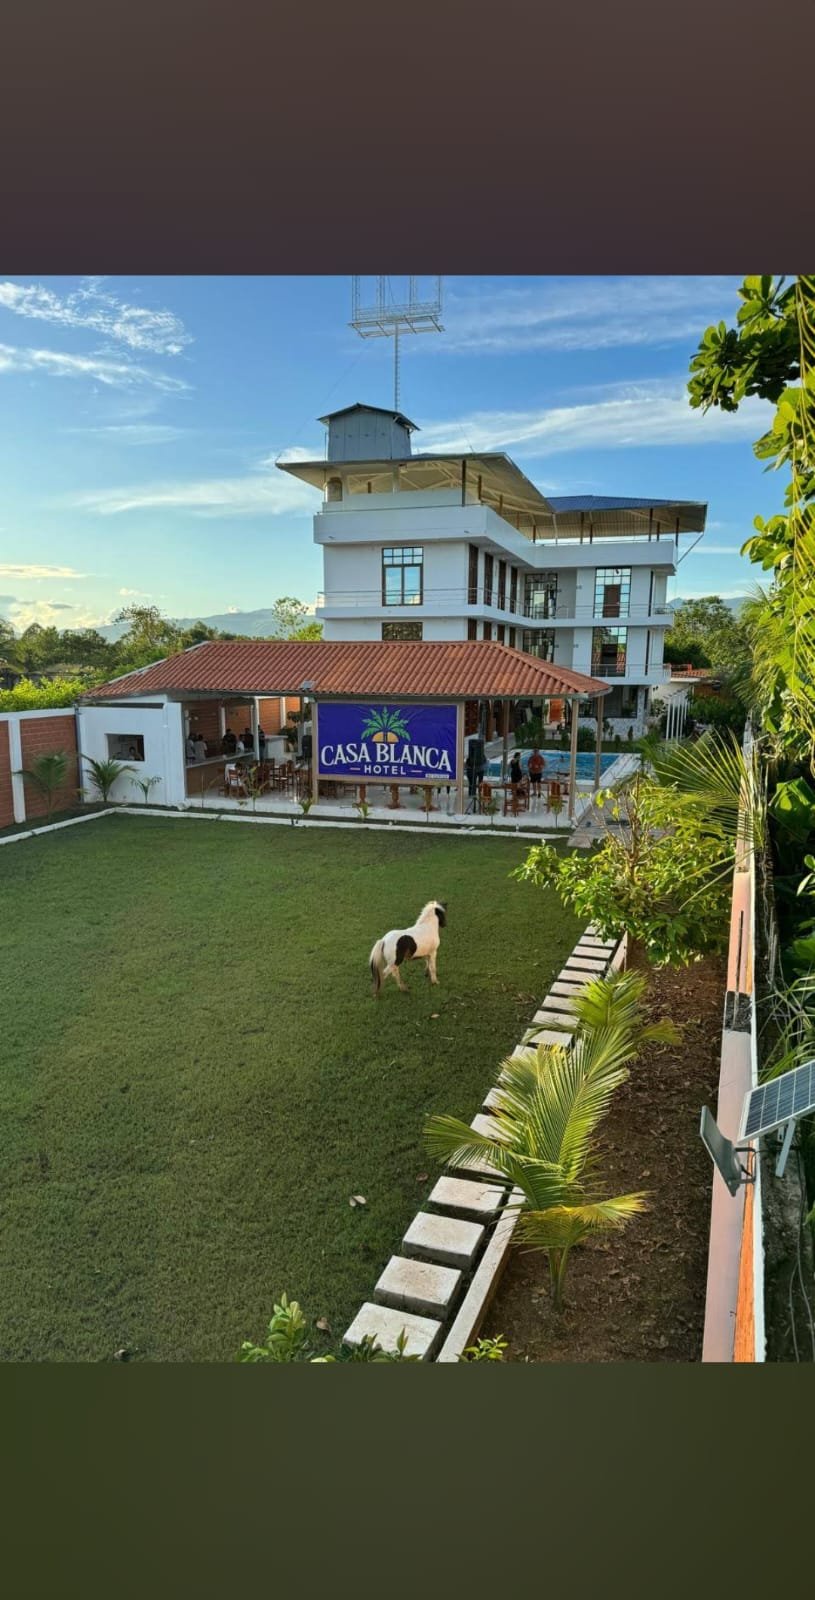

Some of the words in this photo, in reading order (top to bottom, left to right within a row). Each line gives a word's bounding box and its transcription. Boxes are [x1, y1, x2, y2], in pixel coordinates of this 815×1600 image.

[321, 743, 371, 767] CASA
[376, 743, 452, 772] BLANCA
[364, 764, 407, 775] HOTEL
